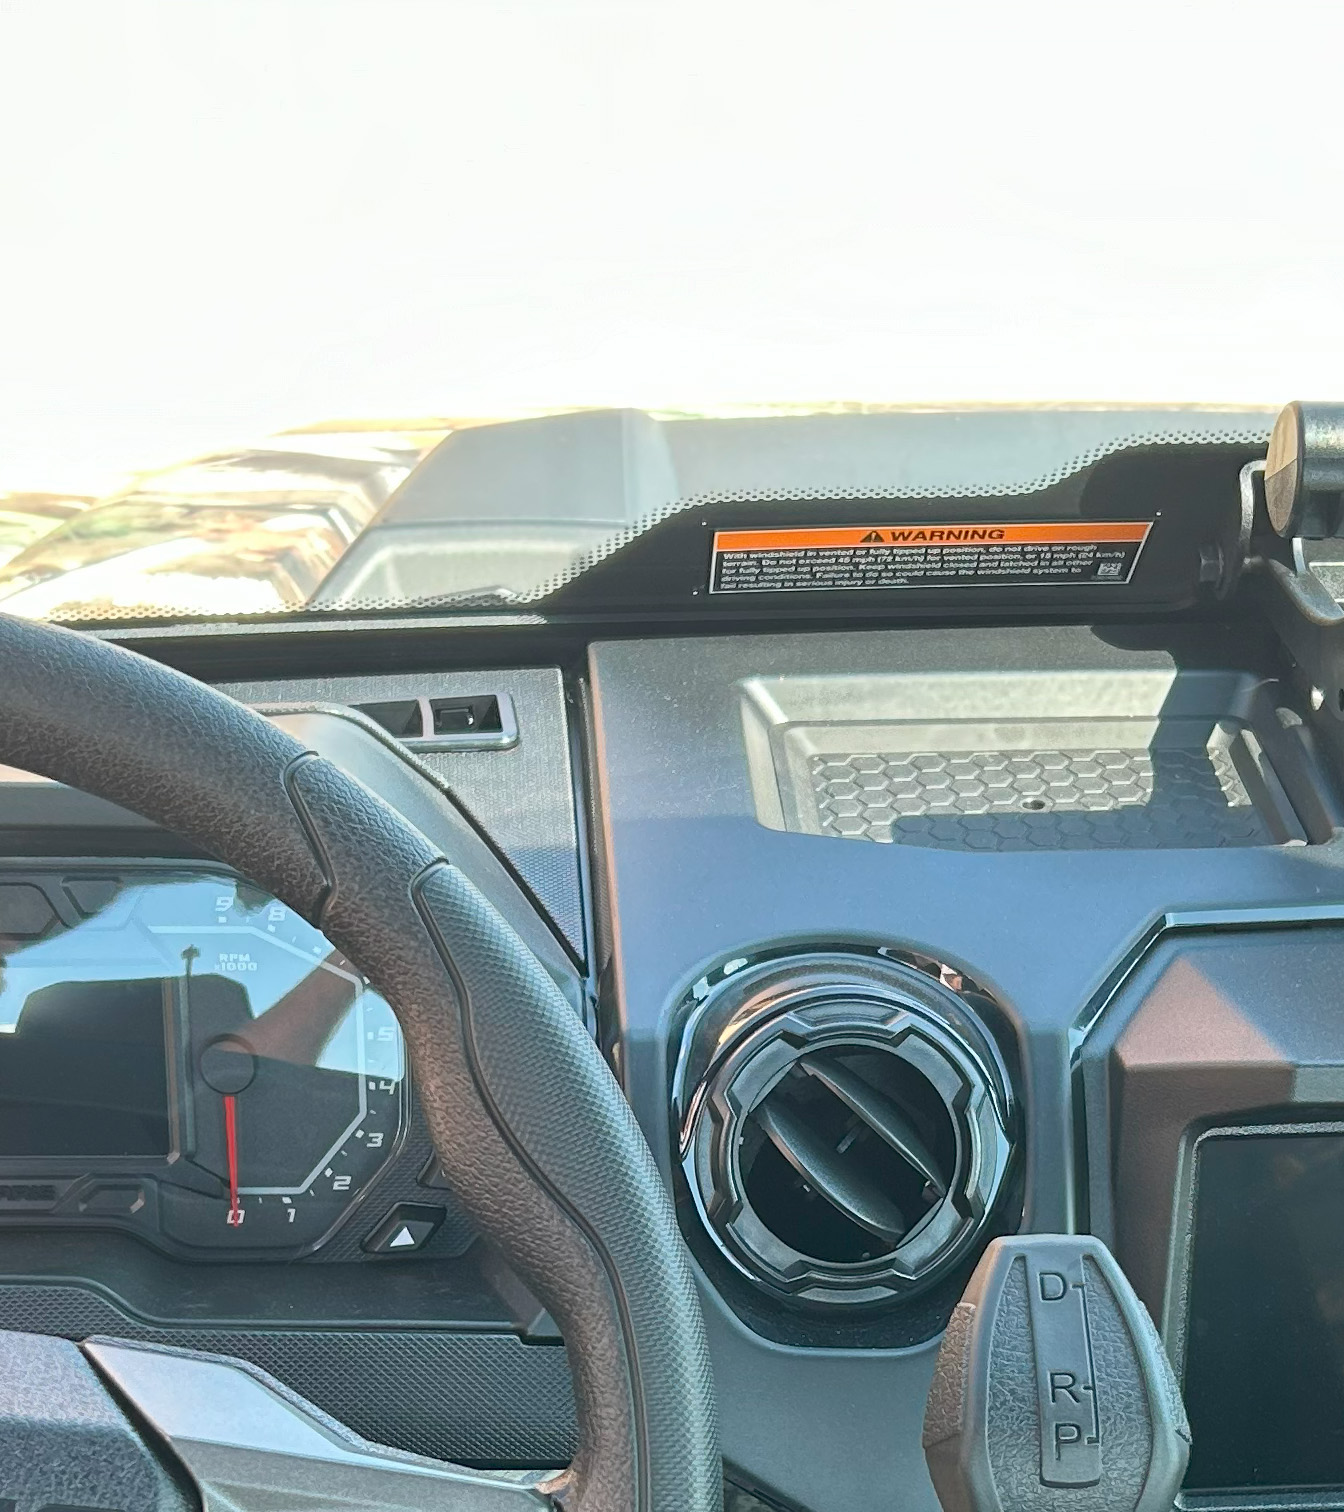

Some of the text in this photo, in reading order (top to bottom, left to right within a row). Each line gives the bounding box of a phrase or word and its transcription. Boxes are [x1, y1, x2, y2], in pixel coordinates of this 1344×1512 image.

[891, 529, 1005, 541] WARNING
[268, 906, 286, 921] 8
[219, 953, 251, 962] RPM
[376, 1026, 396, 1042] 5
[379, 1081, 397, 1095] 4
[366, 1132, 383, 1148] 3
[332, 1175, 352, 1191] 2
[226, 1210, 245, 1224] 0
[286, 1208, 297, 1223] 1
[1038, 1271, 1068, 1302] D
[1048, 1372, 1081, 1404] R
[1054, 1422, 1082, 1461] P
